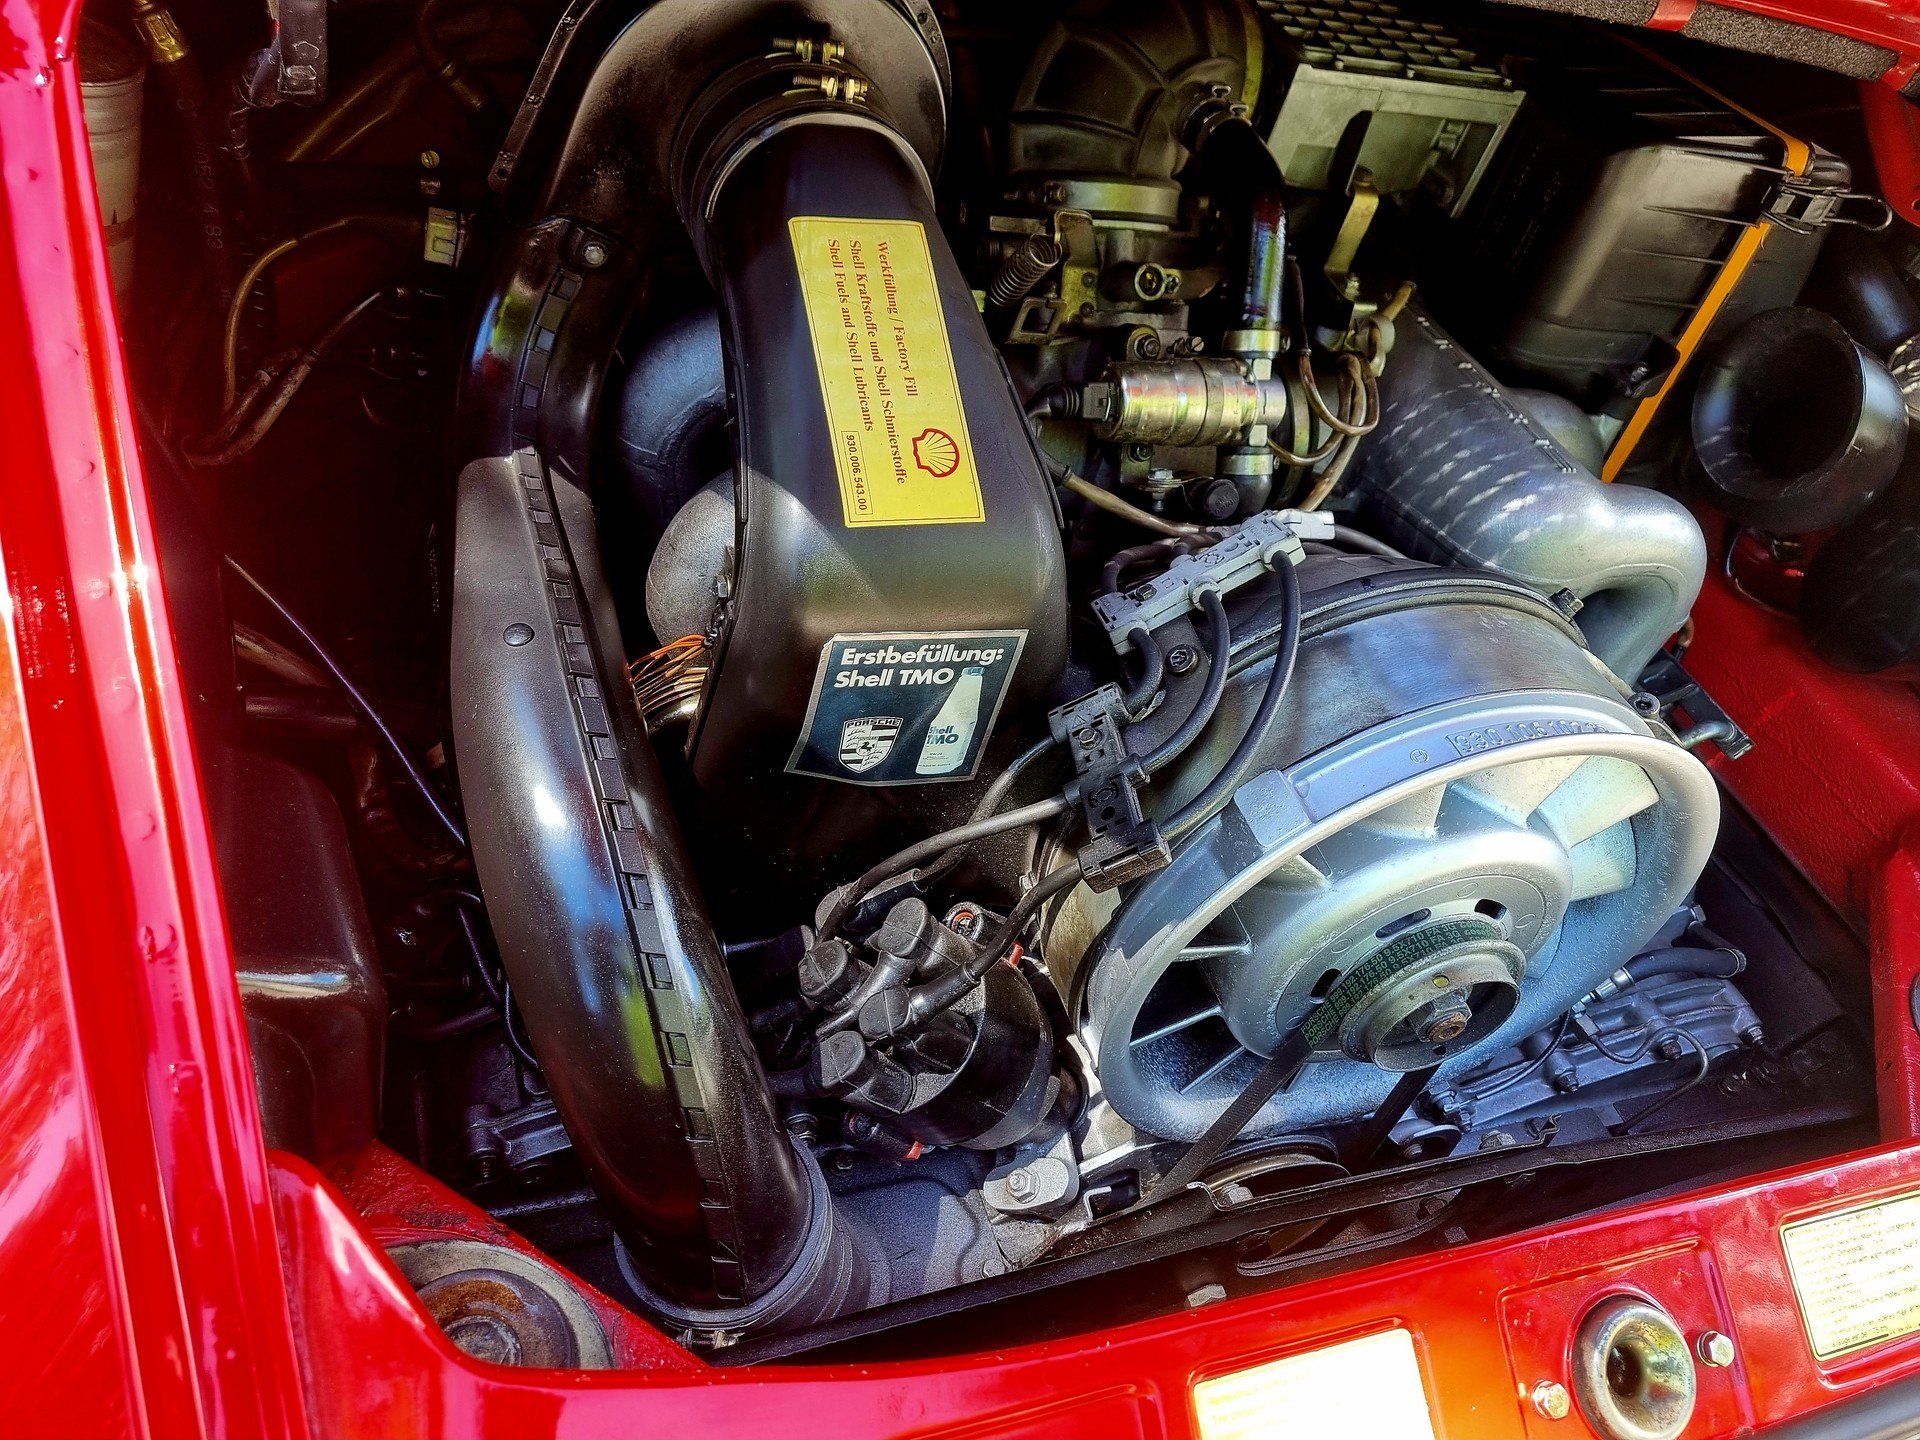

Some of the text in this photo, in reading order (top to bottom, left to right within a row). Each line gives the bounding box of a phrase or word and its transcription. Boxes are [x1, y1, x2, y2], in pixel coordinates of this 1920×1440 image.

[828, 239, 874, 432] Shell Fuels and Shell Lubricants
[877, 241, 899, 315] Werkfüllung
[893, 326, 910, 372] Factory
[904, 376, 918, 397] Fill
[850, 239, 908, 484] Shell Kraftstoffe und Shell Schmierstoffe
[846, 434, 867, 511] 930.006.543.00
[833, 668, 955, 688] Shell TMO
[840, 643, 1004, 666] Erstbefüllung:
[846, 718, 901, 728] PORSCHE
[926, 733, 960, 745] TMO
[928, 725, 954, 735] Shell
[1300, 1000, 1332, 1034] PORSCHE
[1329, 954, 1383, 1003] 999.192.176.50
[1383, 932, 1425, 956] 9.5X710
[1425, 927, 1440, 937] FA
[1304, 931, 1461, 1042] PORSCHE 999.192.176.50 9.5X710 FA 3G
[1308, 1014, 1340, 1049] PORSCHE
